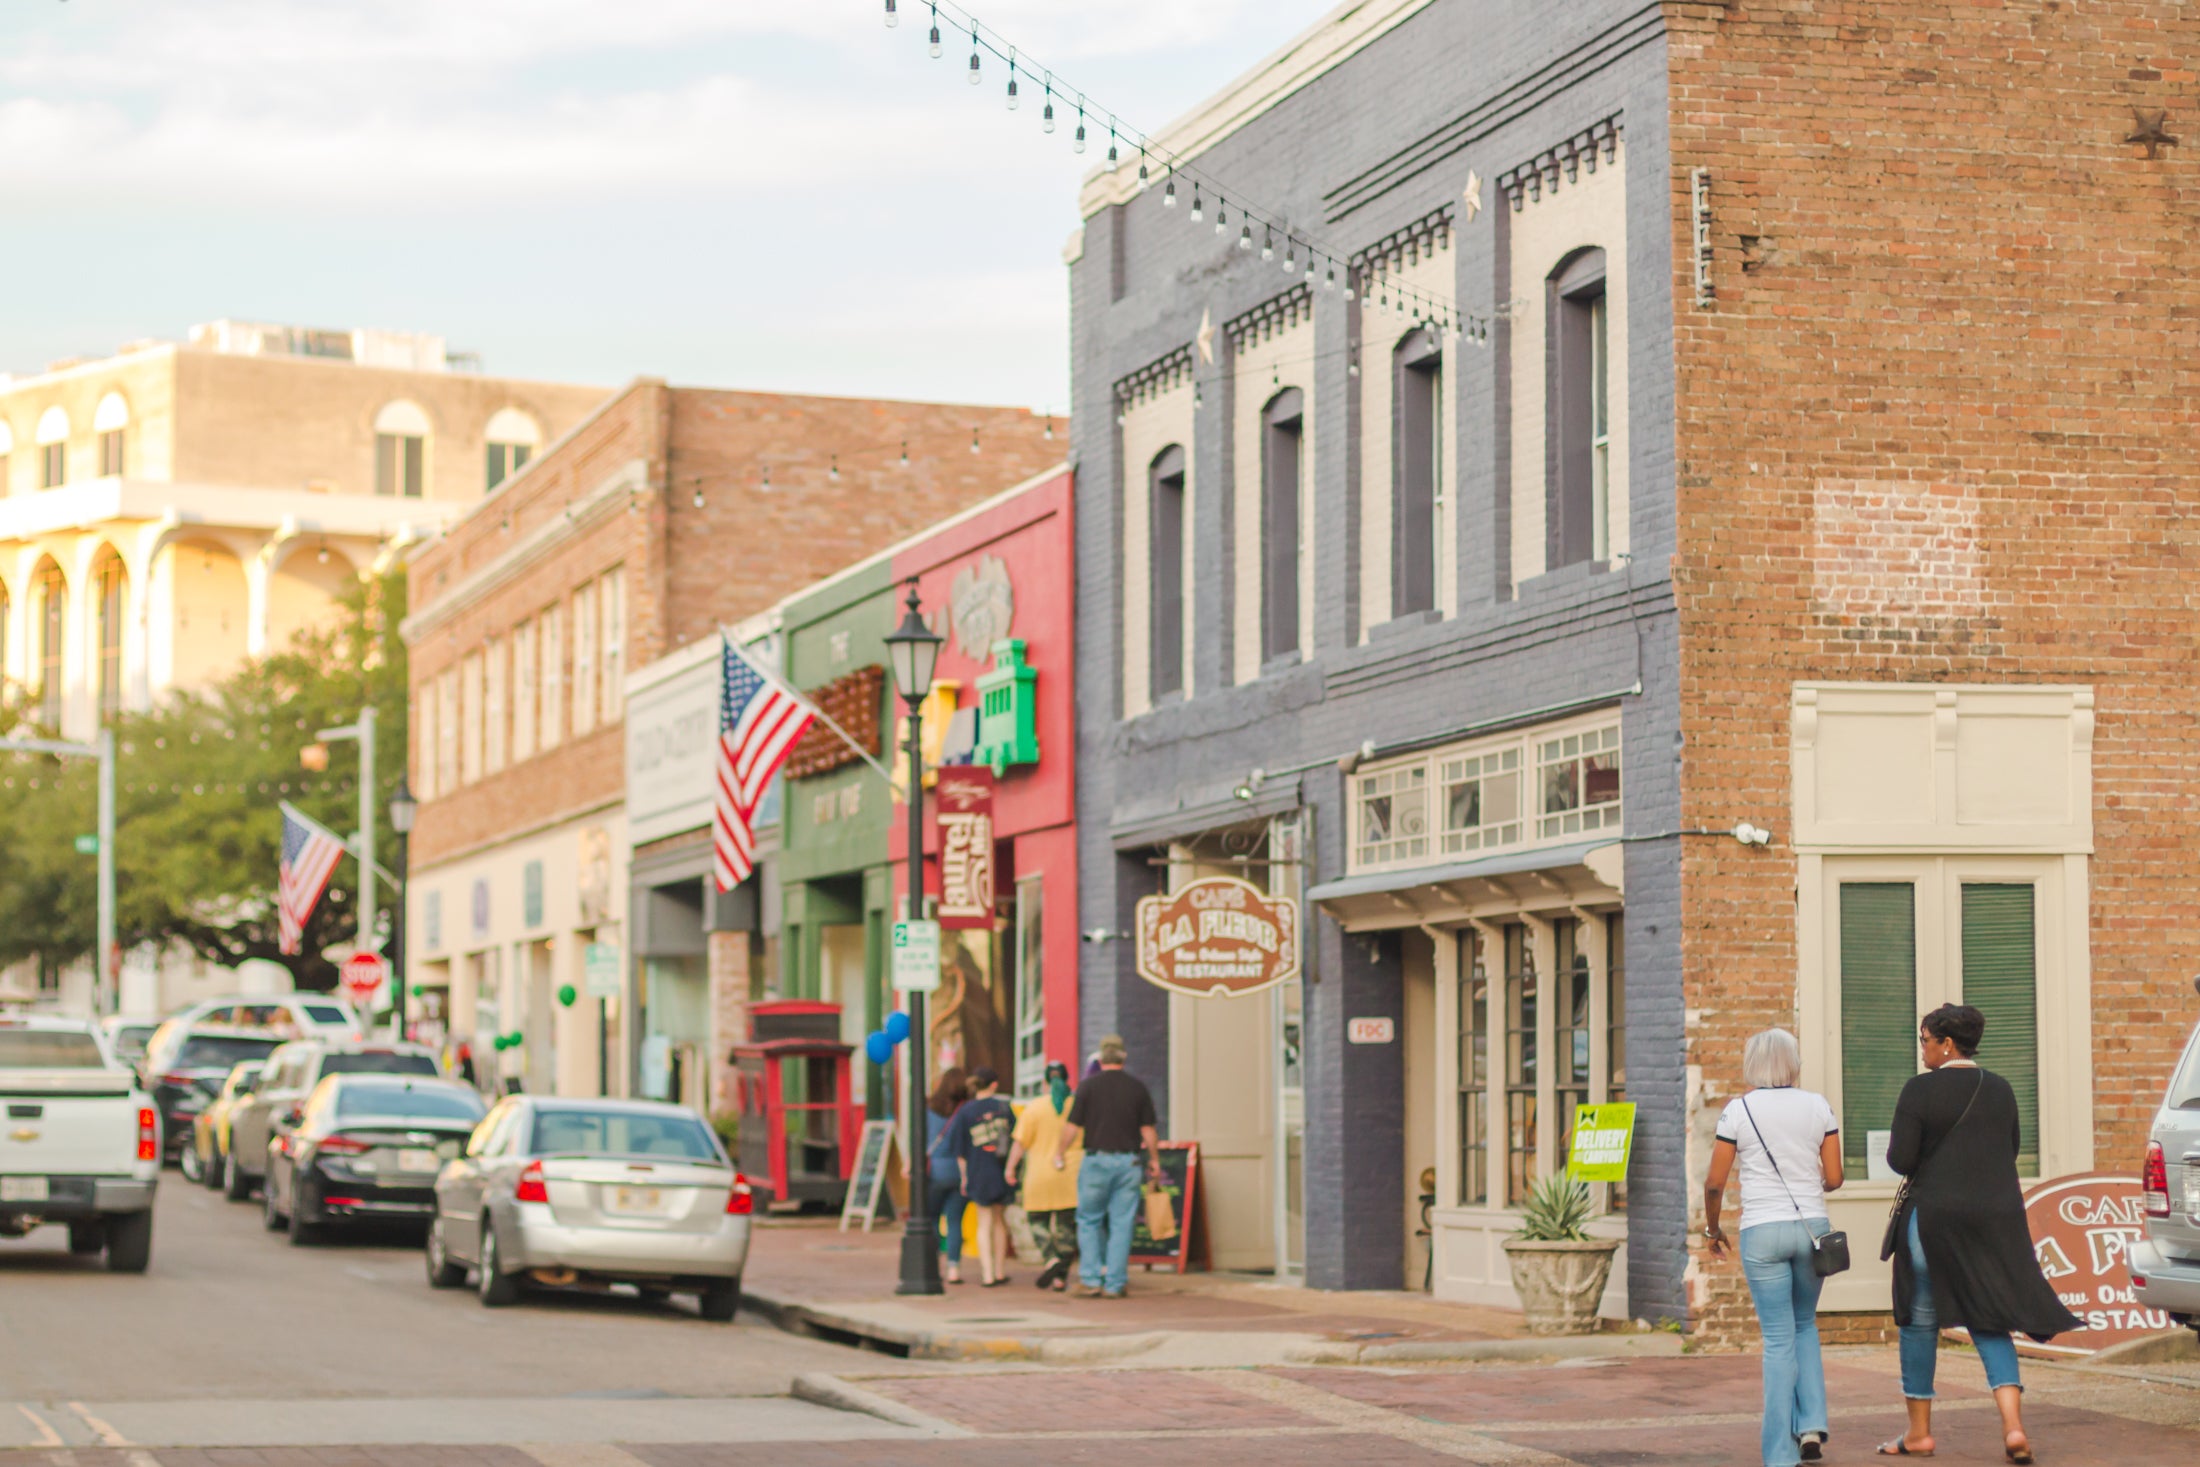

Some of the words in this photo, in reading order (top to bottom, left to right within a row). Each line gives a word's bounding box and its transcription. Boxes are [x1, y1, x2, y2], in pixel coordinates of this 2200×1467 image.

[1159, 914, 1195, 953] LA
[1198, 910, 1278, 953] FLEUR
[344, 963, 382, 985] STOP
[1174, 963, 1264, 979] RESTAURANT
[1357, 1023, 1384, 1038] FDC
[1574, 1129, 1628, 1150] DELIVERY
[1583, 1149, 1626, 1165] CARRYOUT
[2058, 1195, 2145, 1226] CAF
[2035, 1236, 2077, 1280] A
[2059, 1291, 2089, 1306] ew
[2072, 1308, 2168, 1332] ESTAU
